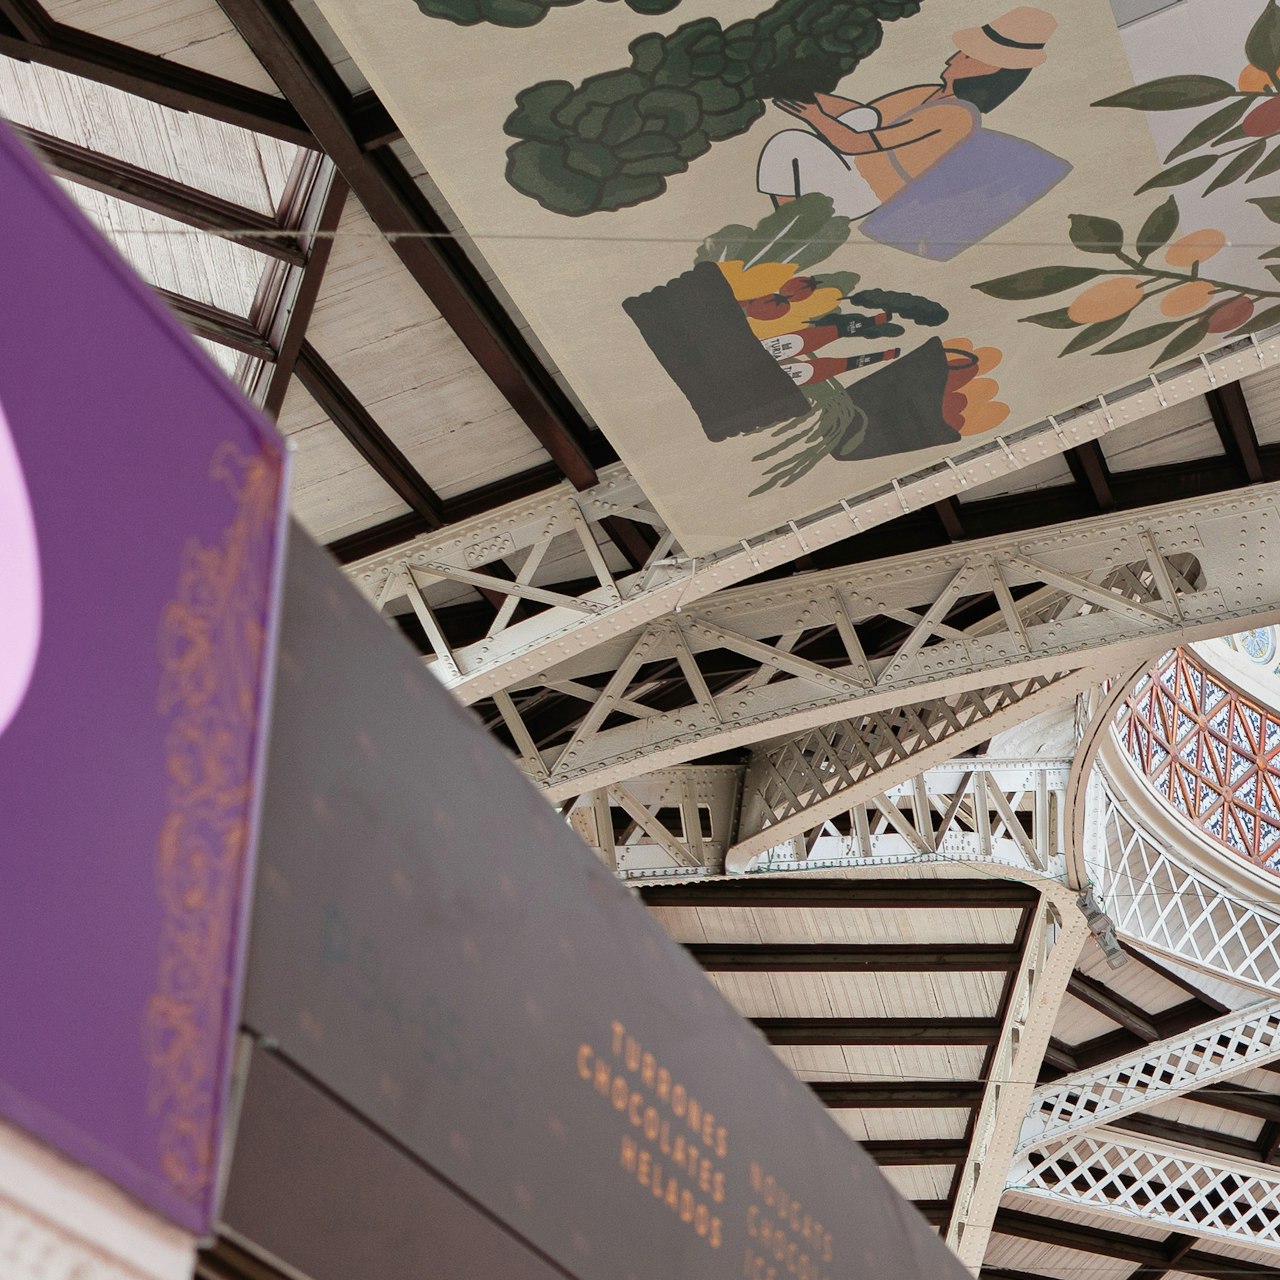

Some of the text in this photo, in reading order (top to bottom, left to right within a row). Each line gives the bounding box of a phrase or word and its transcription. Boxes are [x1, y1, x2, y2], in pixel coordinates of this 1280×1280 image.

[577, 1043, 726, 1204] CHOCOLATES
[611, 1019, 729, 1160] TURRONES
[620, 1134, 722, 1249] HELADOS
